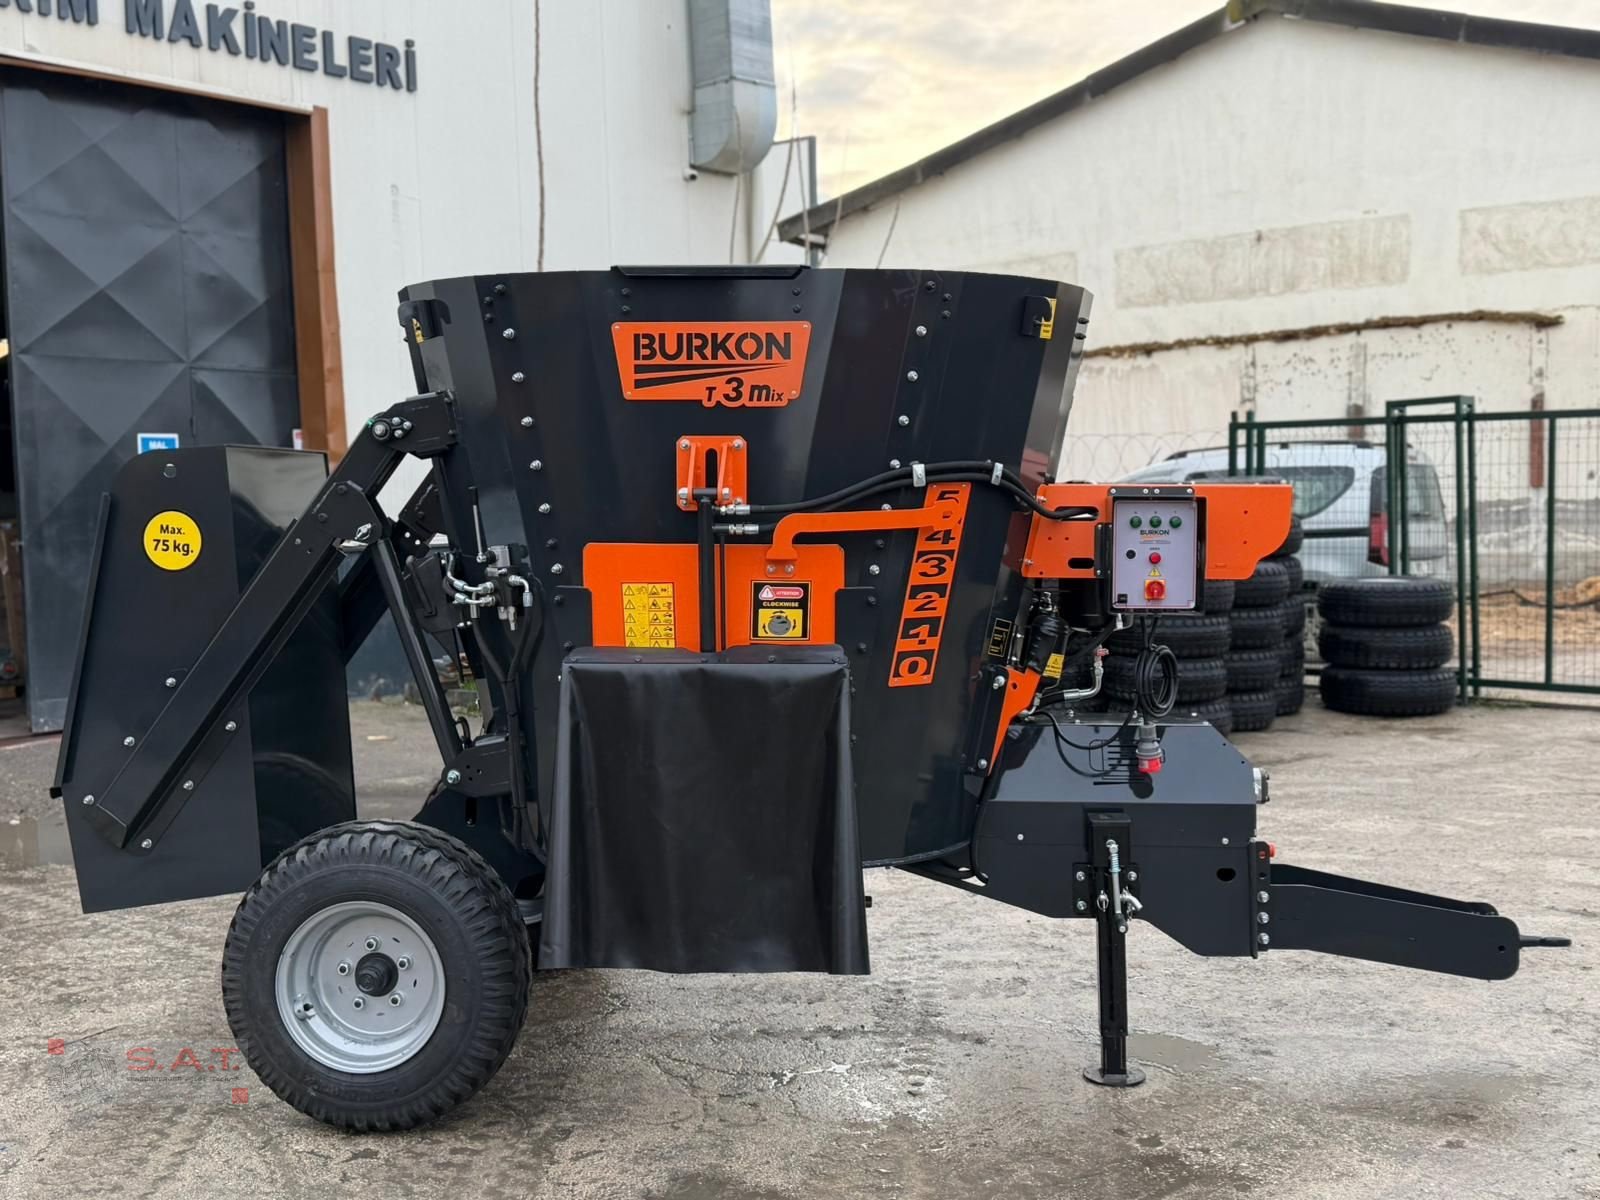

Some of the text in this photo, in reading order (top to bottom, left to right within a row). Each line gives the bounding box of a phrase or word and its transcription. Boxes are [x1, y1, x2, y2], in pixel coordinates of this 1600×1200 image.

[124, 0, 418, 92] MAKİNELERİ
[633, 332, 792, 361] BURKON
[723, 377, 744, 402] 3
[159, 524, 186, 535] Max.
[153, 539, 194, 556] 75 kg.
[917, 556, 947, 578] 3
[913, 591, 942, 612] 2
[908, 624, 931, 645] 1
